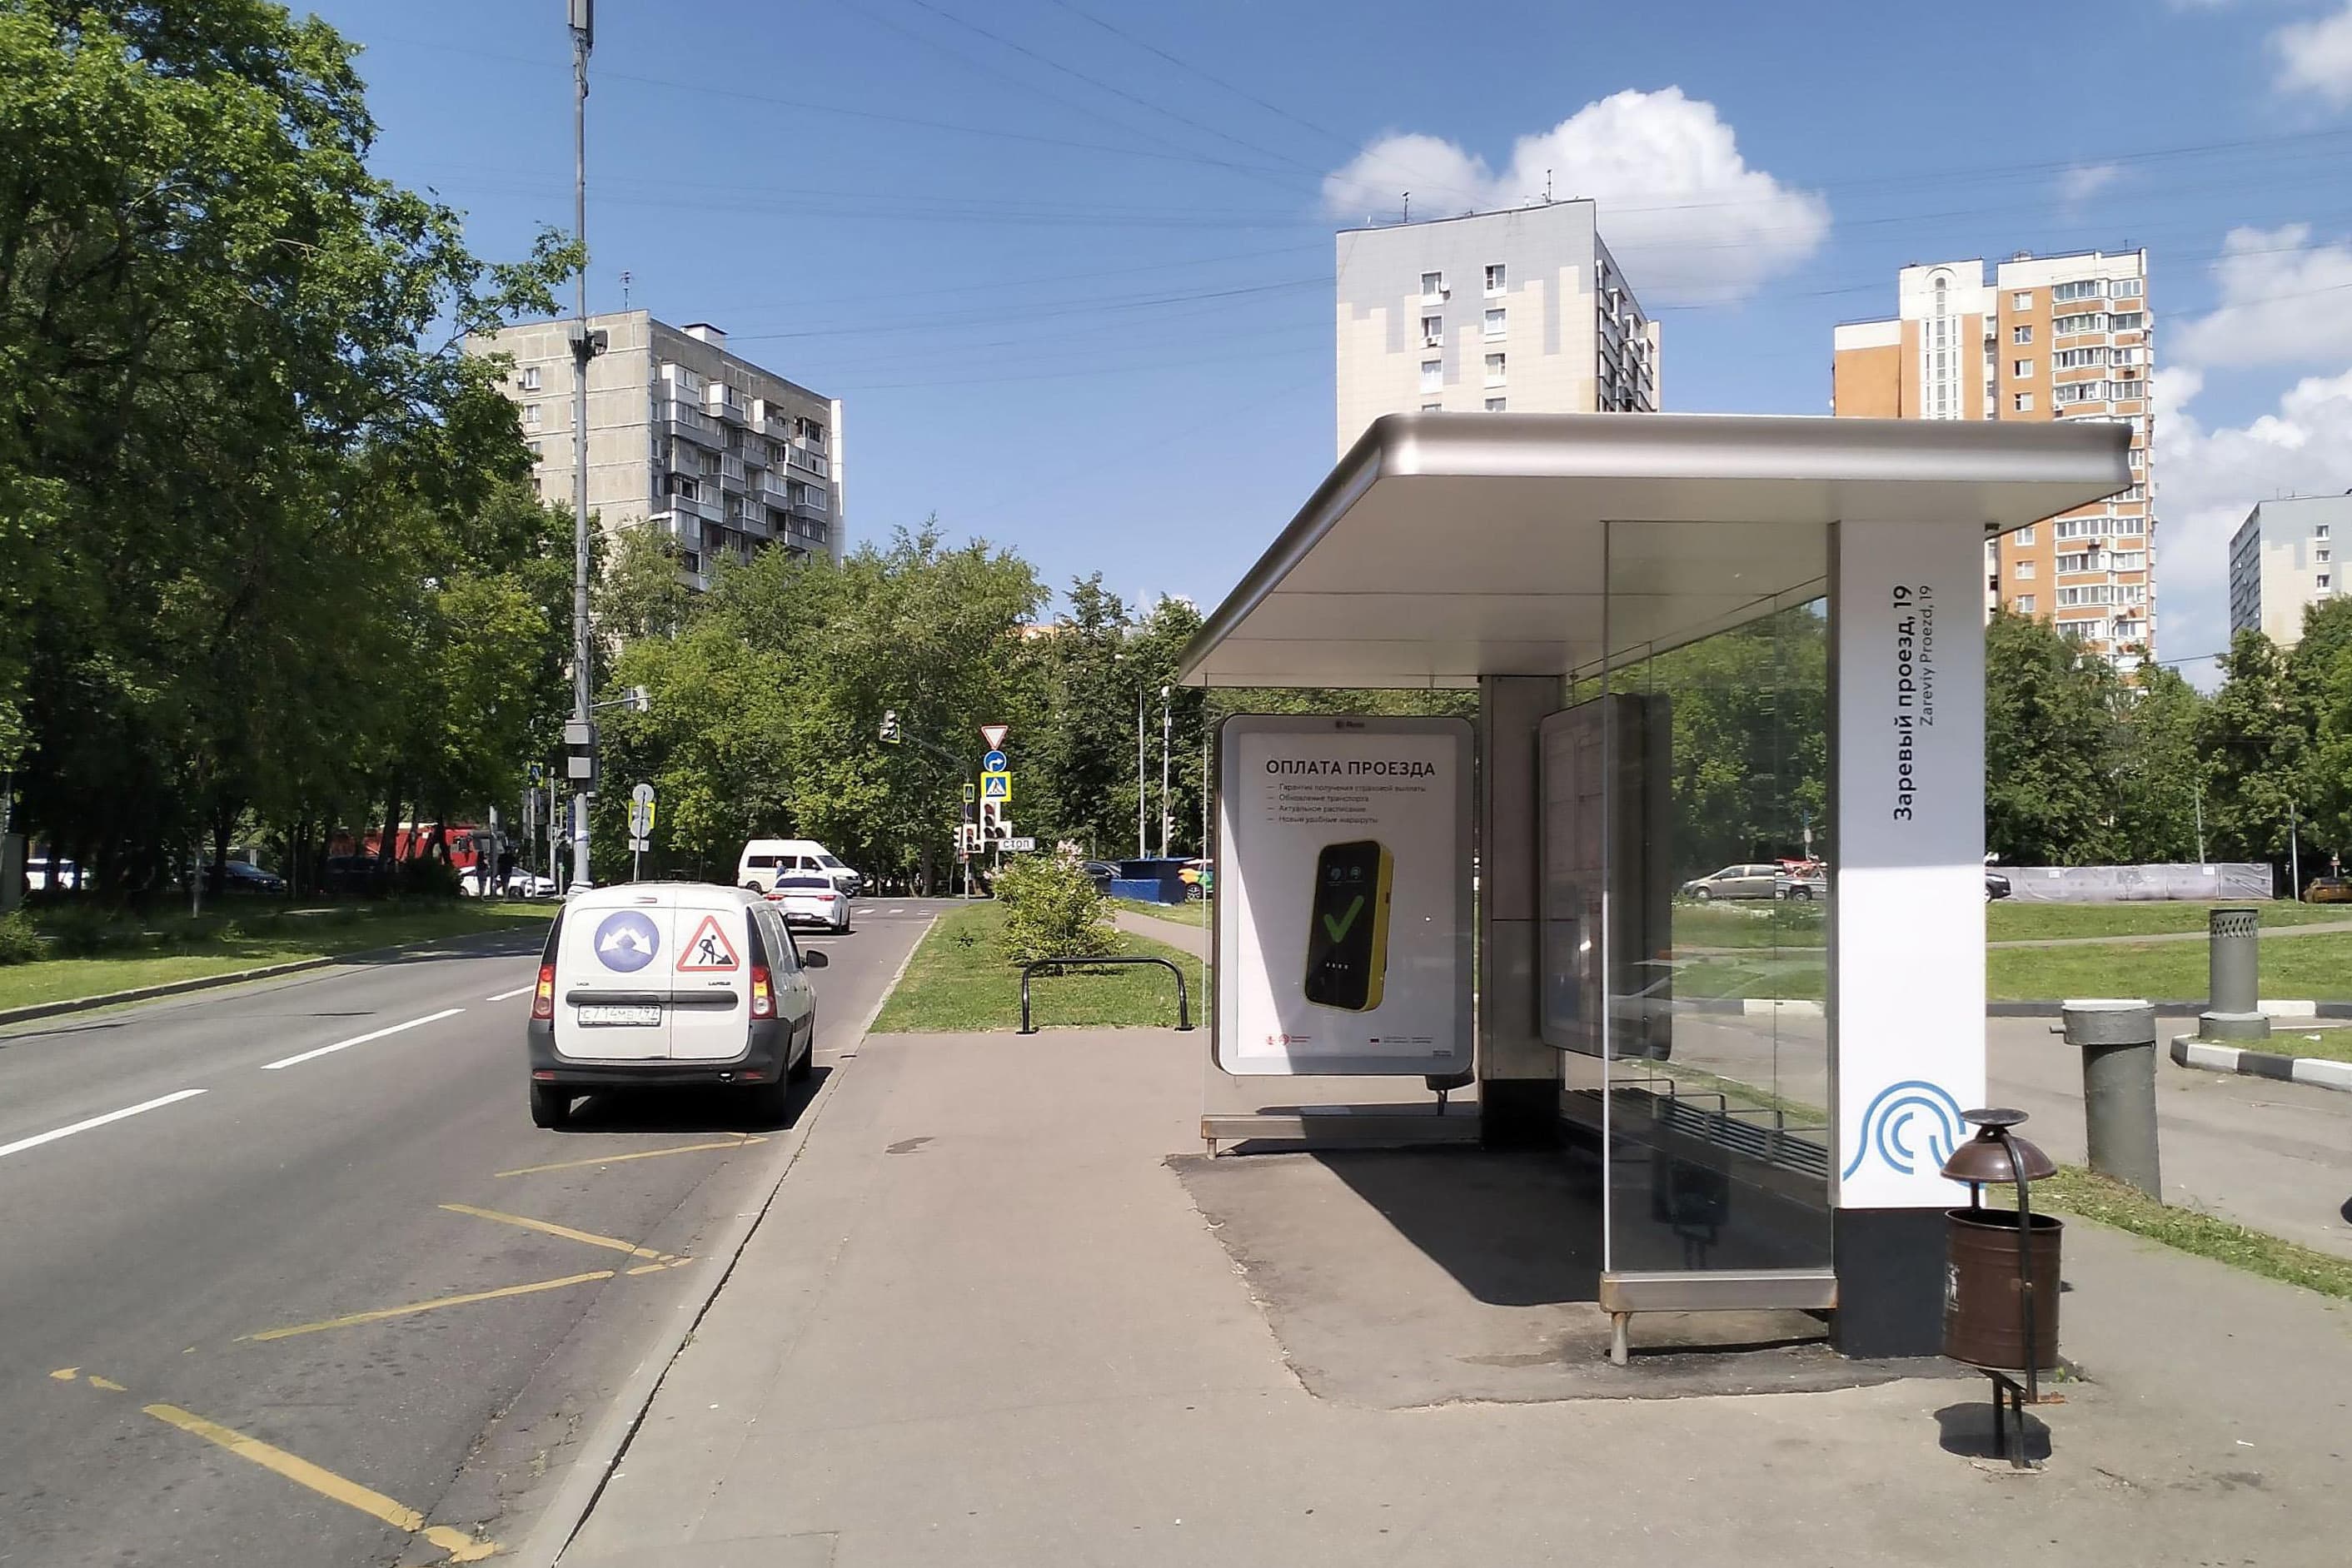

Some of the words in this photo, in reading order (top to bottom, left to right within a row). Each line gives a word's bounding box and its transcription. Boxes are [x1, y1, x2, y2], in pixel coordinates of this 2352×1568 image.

[1893, 585, 1913, 609] 19
[1919, 585, 1933, 600] 19
[1919, 605, 1935, 663] Proezd,
[1898, 615, 1916, 707] проезд,
[1919, 667, 1936, 727] Zareviy
[1266, 759, 1343, 775] ОПЛАТА
[1348, 761, 1436, 778] ПРОЕЗДА
[1893, 714, 1917, 821] Заревый
[1003, 839, 1030, 849] СТОП
